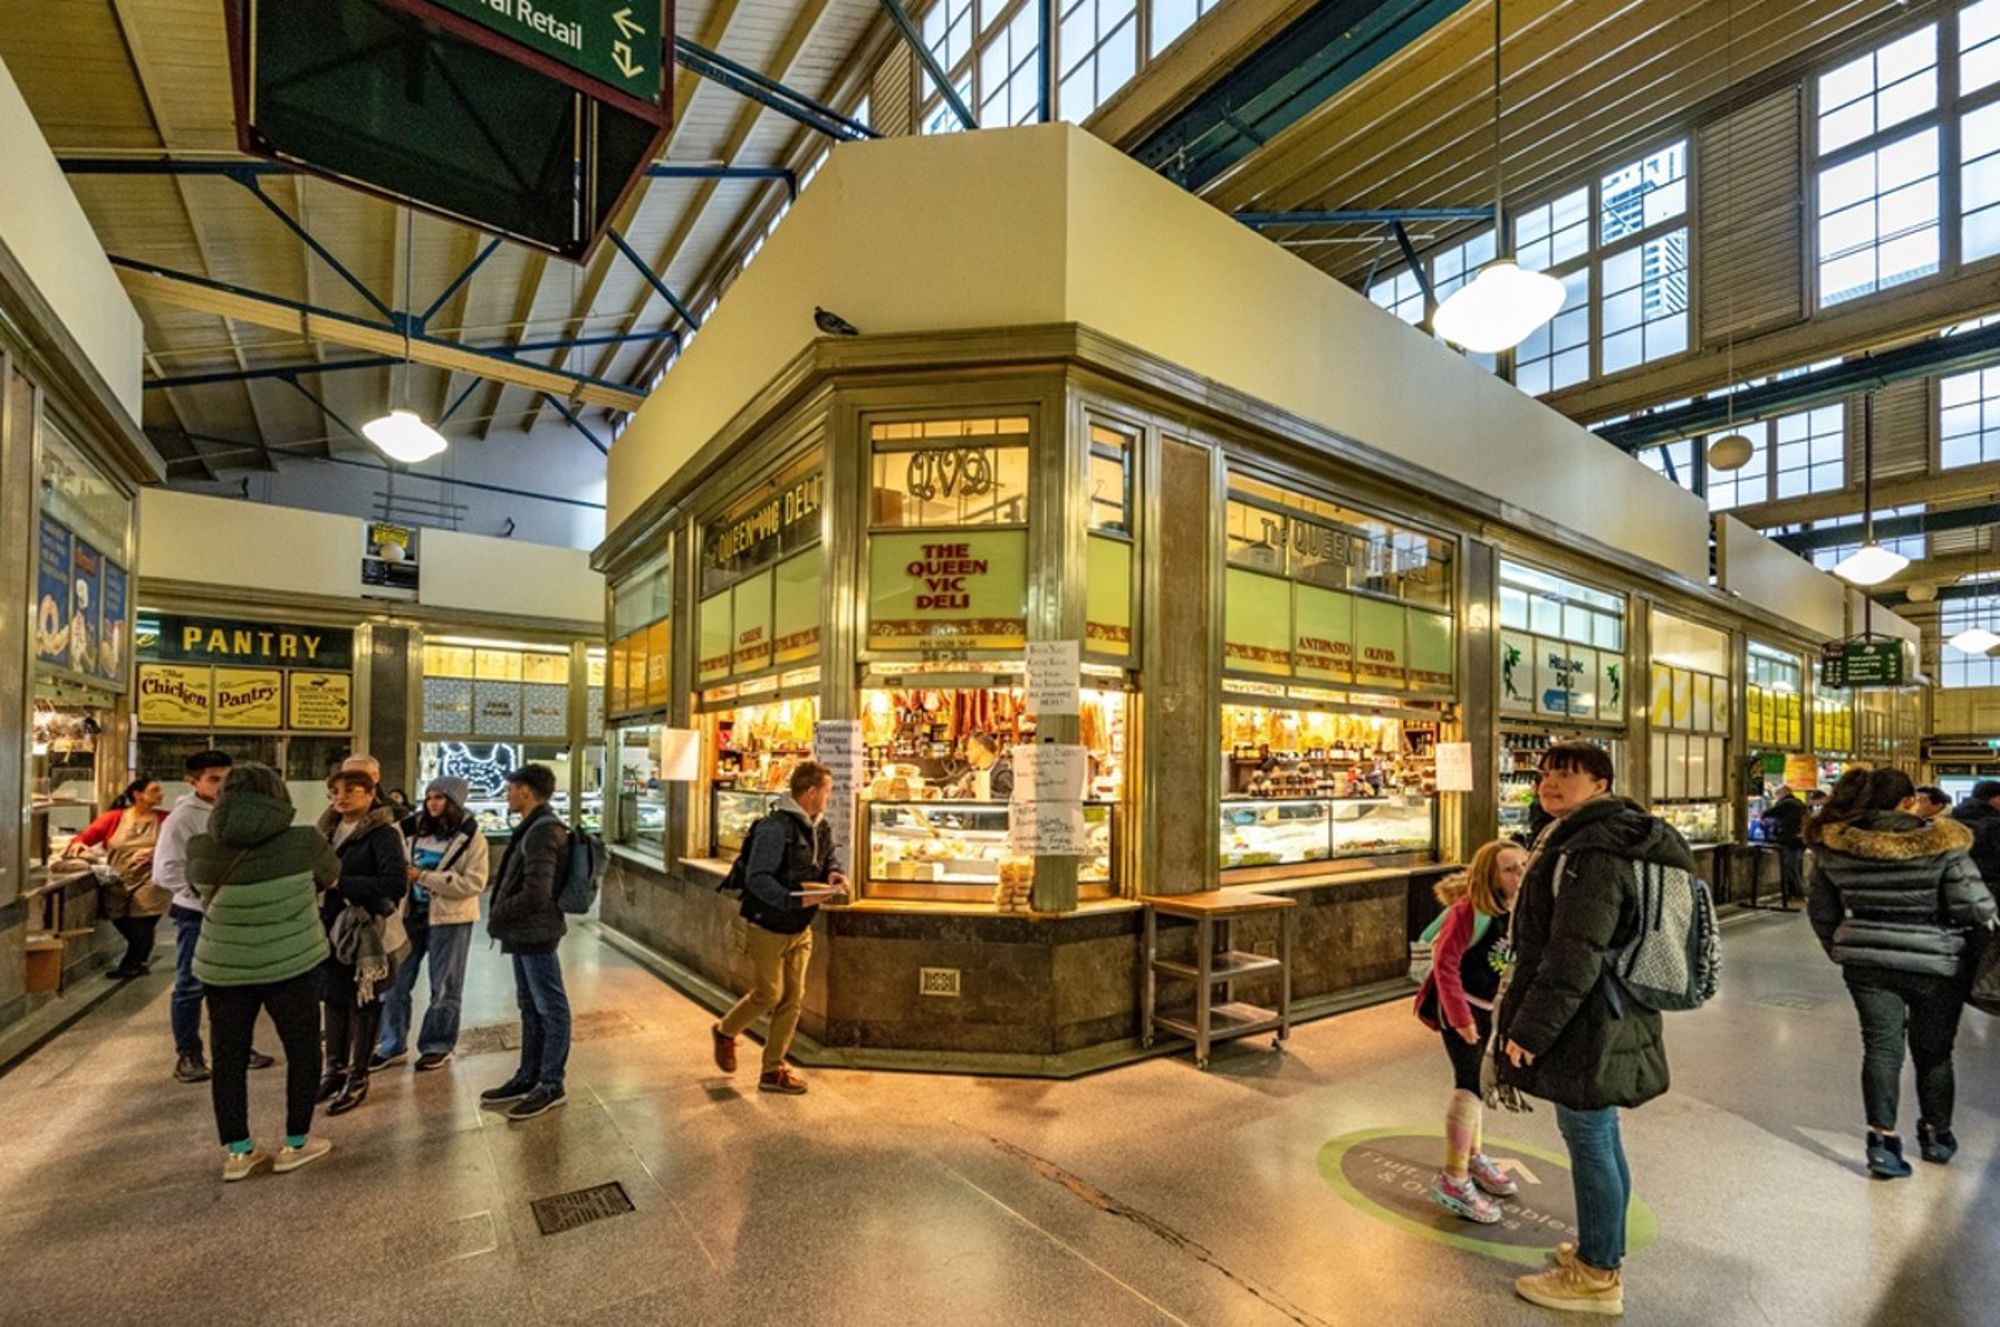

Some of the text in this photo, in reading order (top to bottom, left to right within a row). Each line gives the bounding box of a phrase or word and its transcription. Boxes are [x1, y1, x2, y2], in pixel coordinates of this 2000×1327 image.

[517, 2, 582, 50] Retail
[784, 474, 819, 526] DELI
[921, 543, 970, 558] THE
[908, 560, 988, 577] QUEEN
[926, 577, 966, 592] VIC
[916, 595, 971, 610] DELI
[183, 626, 321, 659] PANTRY
[142, 678, 278, 709] Chicken Pantry
